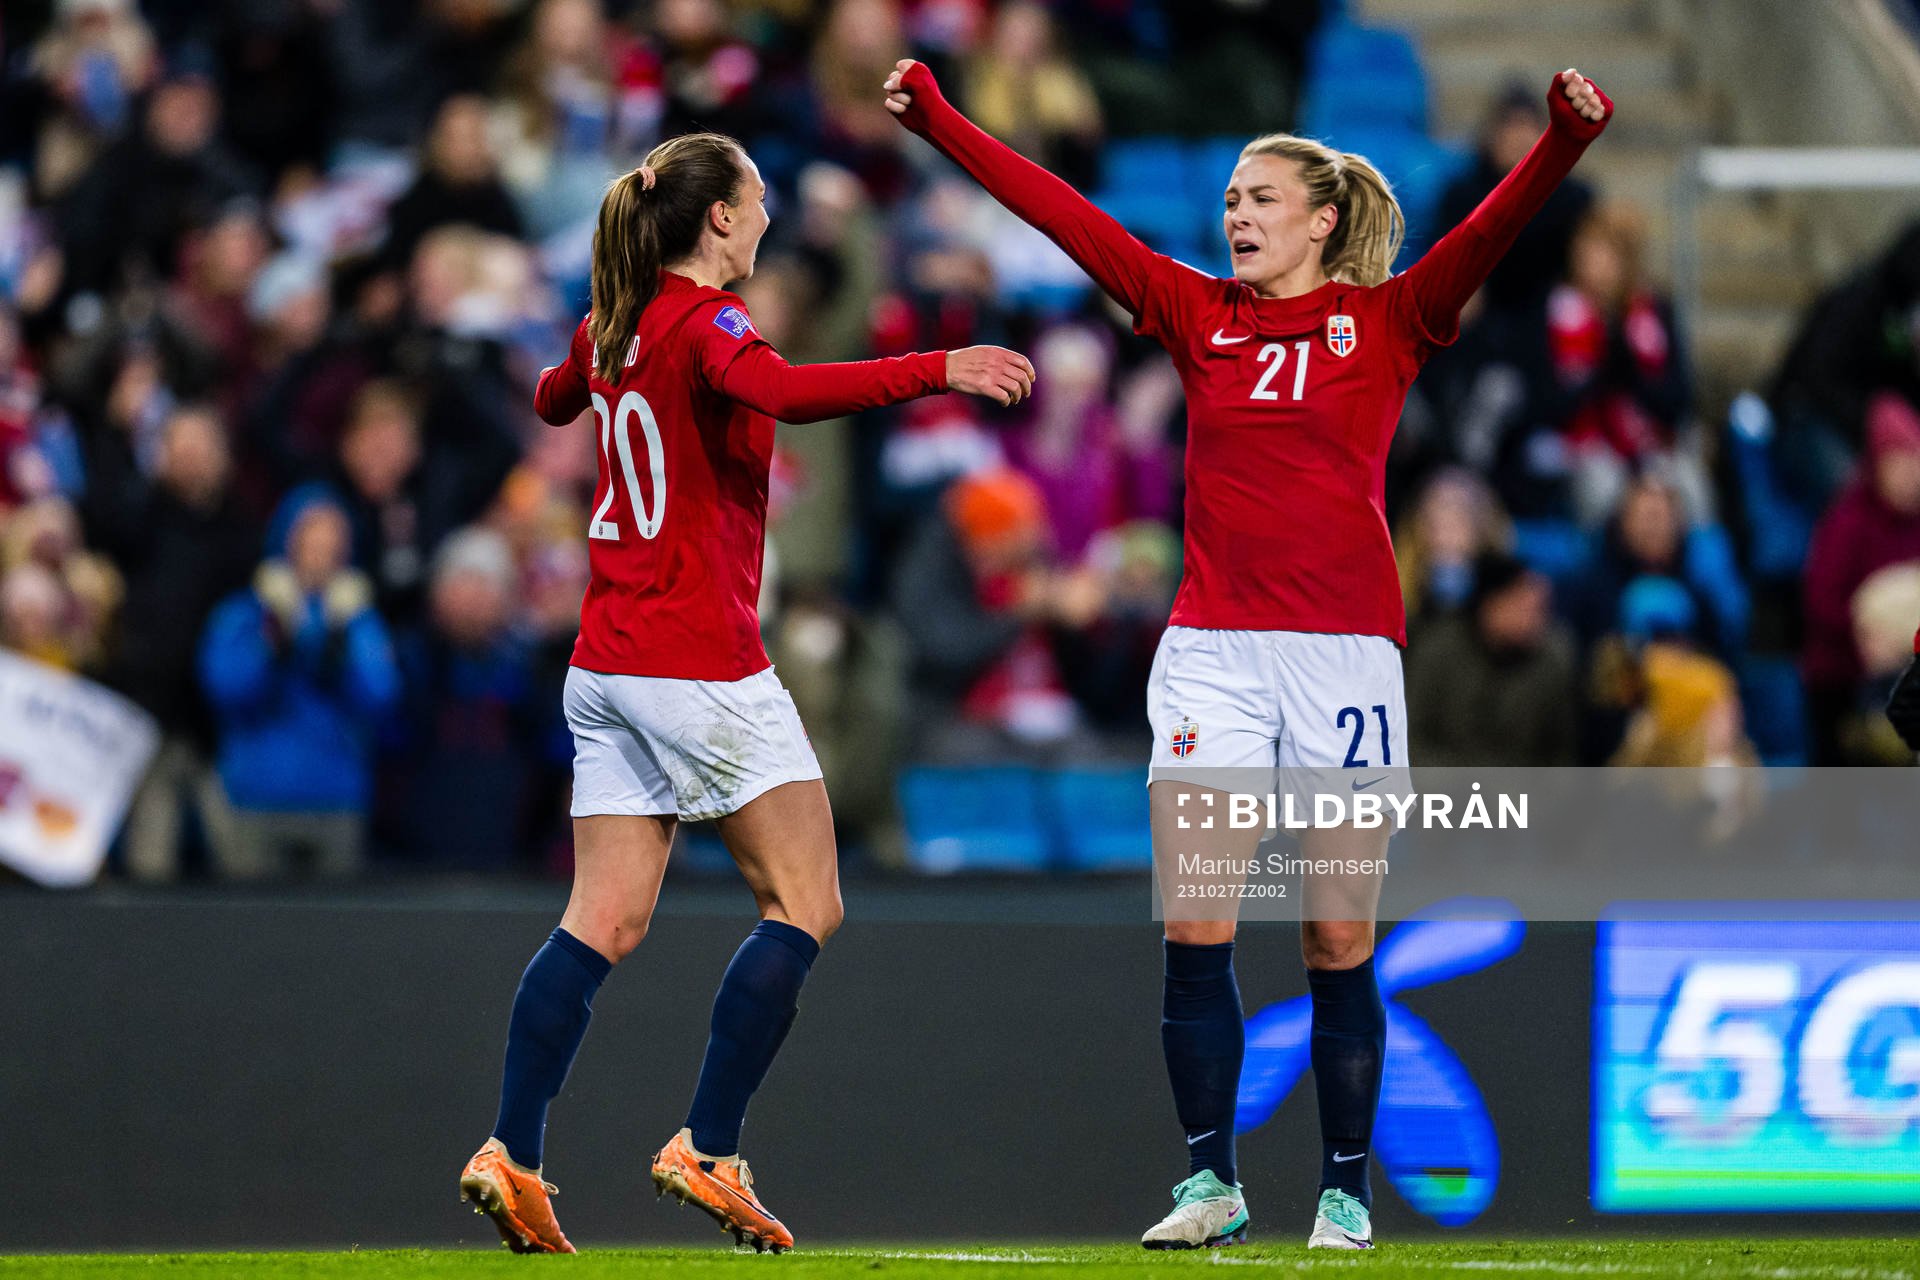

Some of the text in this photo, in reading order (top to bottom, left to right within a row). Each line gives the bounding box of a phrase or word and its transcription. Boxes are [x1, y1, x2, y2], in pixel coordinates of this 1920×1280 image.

[1249, 340, 1311, 401] 21
[589, 391, 667, 541] 20
[1336, 704, 1392, 768] 21
[1645, 961, 1920, 1148] 5G
